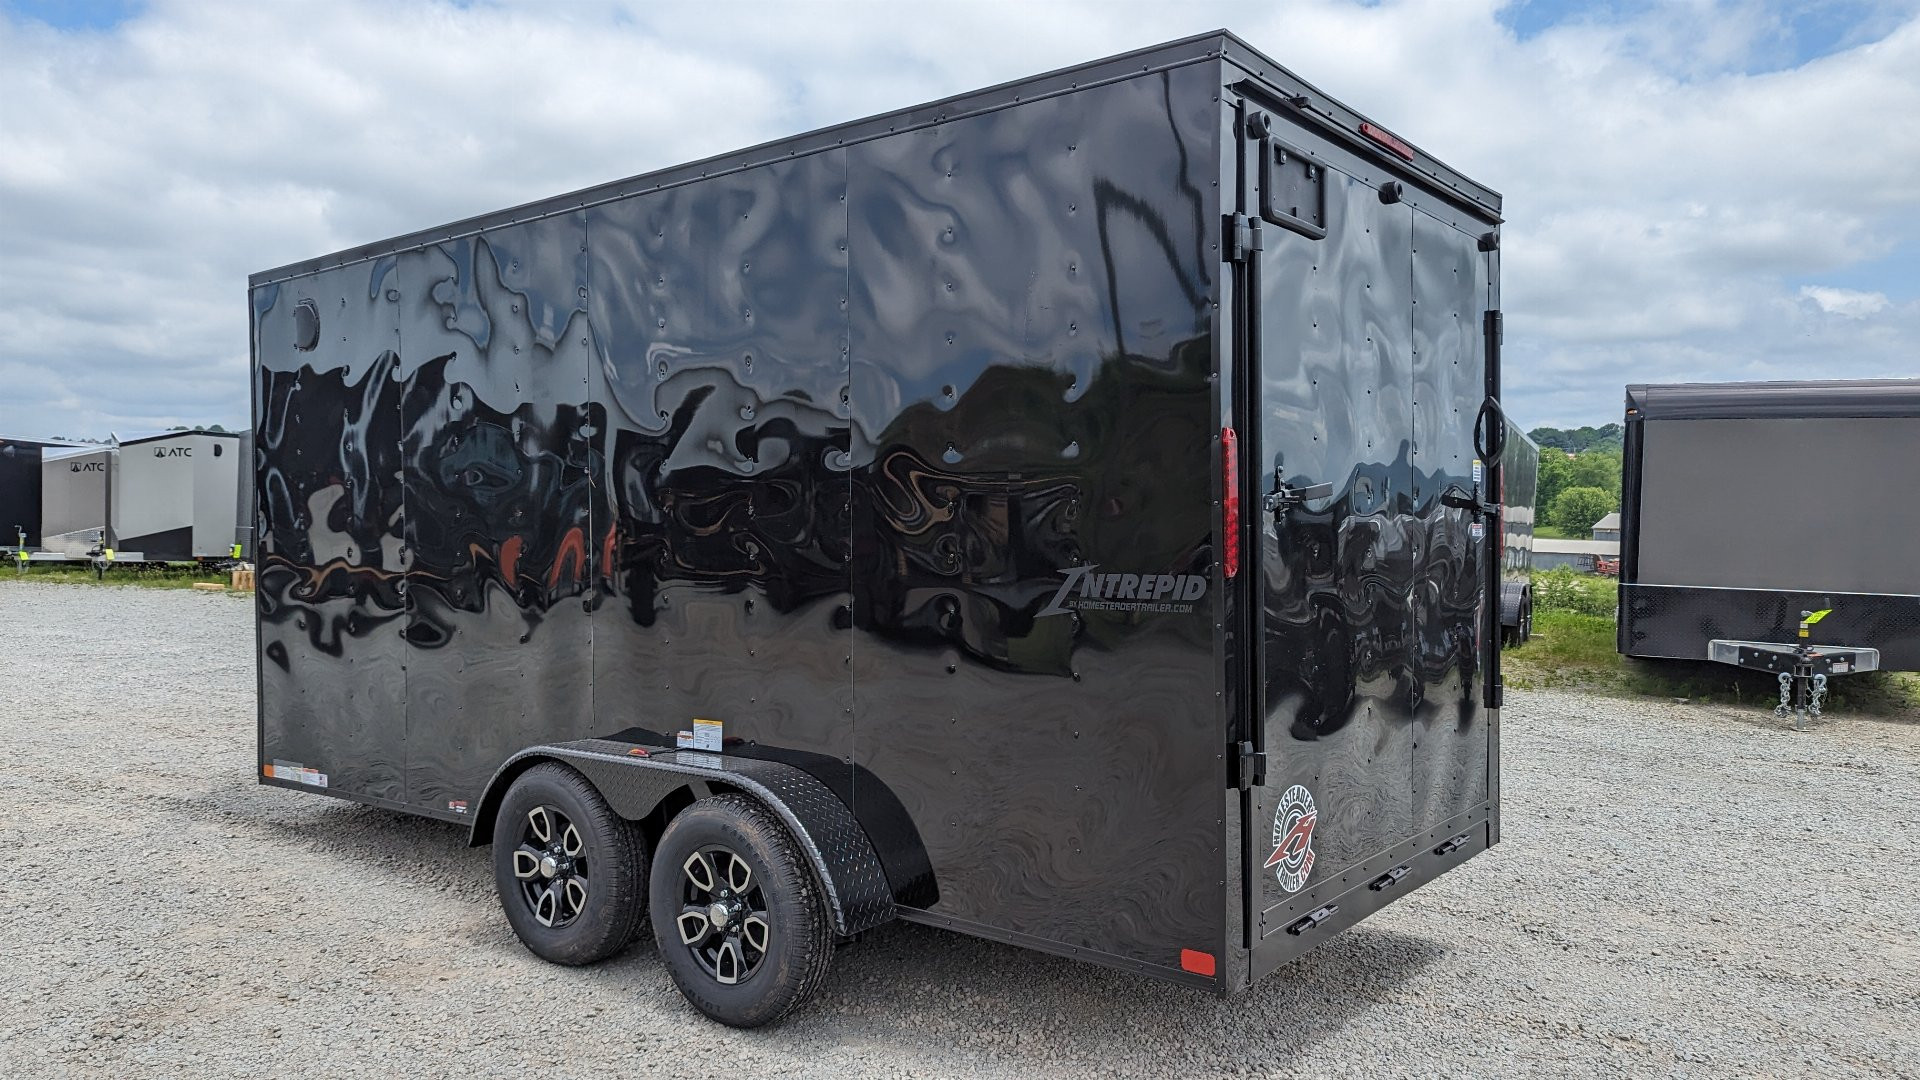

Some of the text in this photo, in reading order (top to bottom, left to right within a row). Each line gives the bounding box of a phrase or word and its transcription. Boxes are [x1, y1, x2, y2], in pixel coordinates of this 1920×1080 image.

[168, 448, 192, 457] ATC
[83, 463, 104, 472] ATC
[1033, 564, 1206, 617] INTREPID
[1078, 601, 1193, 613] HOMESTEADERTRAILER.COM
[1273, 786, 1314, 846] HOMESTEADER
